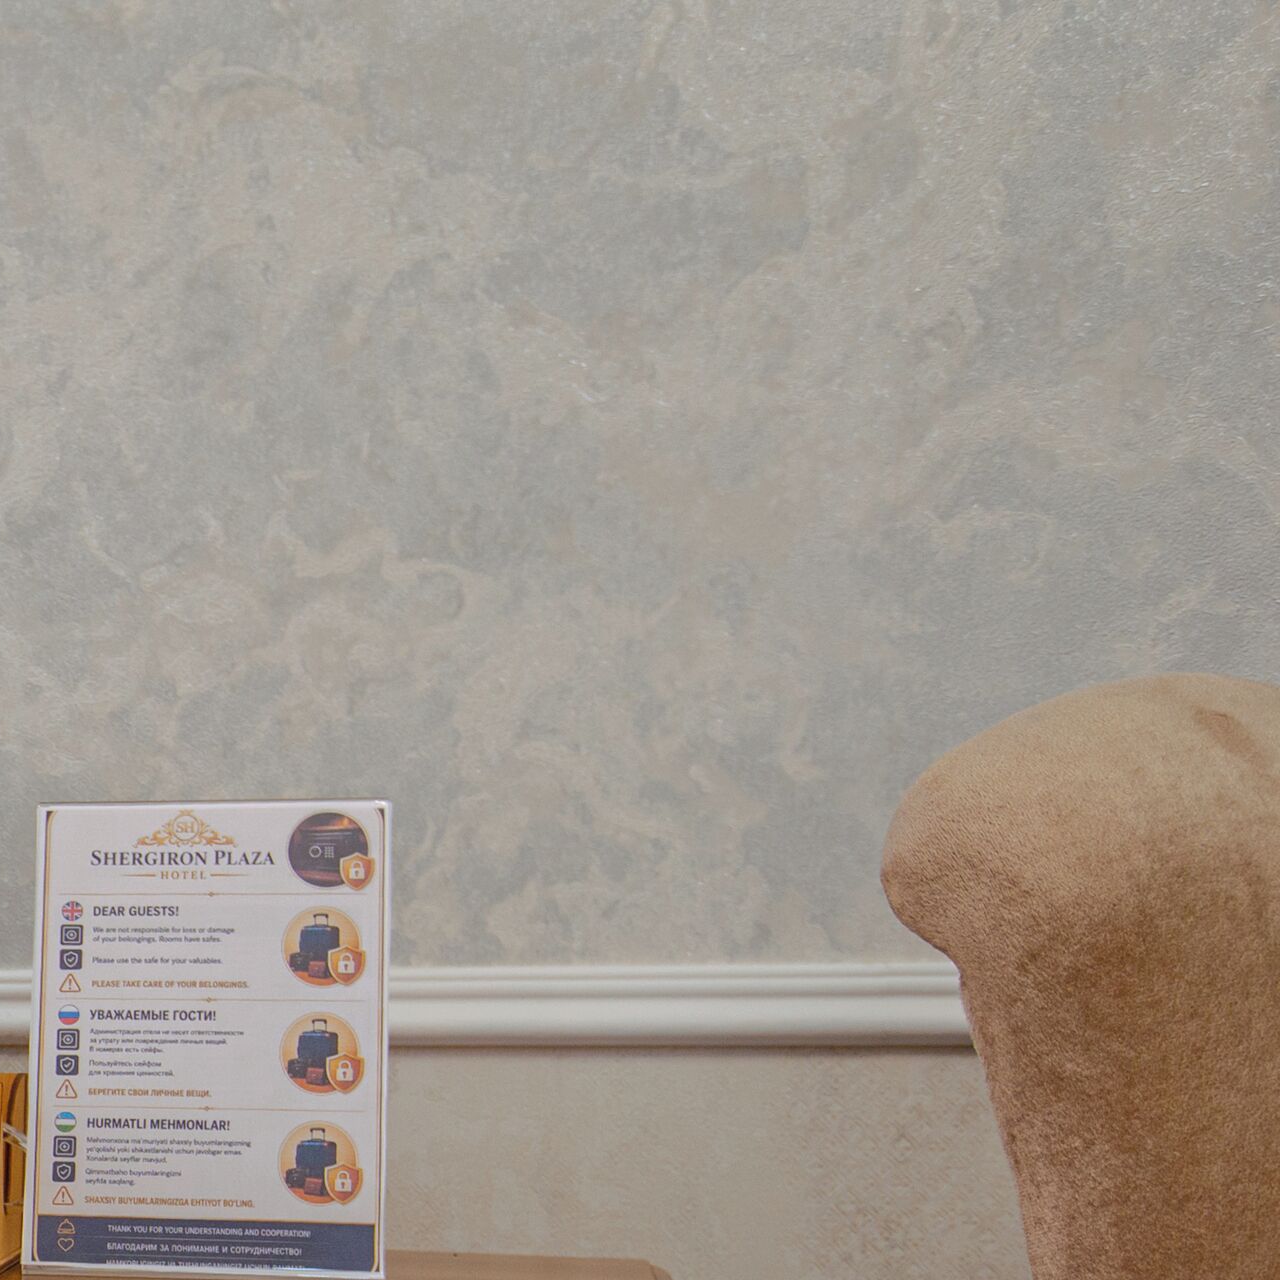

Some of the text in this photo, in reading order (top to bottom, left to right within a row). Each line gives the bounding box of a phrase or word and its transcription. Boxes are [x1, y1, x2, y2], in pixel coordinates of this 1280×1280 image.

[91, 850, 275, 866] SHERGIRON PLAZA
[160, 871, 206, 880] HOTEL
[93, 906, 179, 916] DEAR GUESTS!
[131, 926, 170, 935] responsible
[207, 927, 235, 935] damage
[92, 956, 115, 964] Please
[130, 956, 142, 964] the
[144, 956, 159, 964] safe
[160, 956, 170, 964] for
[92, 980, 120, 988] PLEASE
[122, 980, 140, 988] TAKE
[142, 980, 163, 988] CARE
[165, 980, 174, 988] OF
[177, 980, 197, 988] YOUR
[90, 1009, 217, 1021] УВАЖАЕМЫЕ ГОСТИ!
[88, 1088, 126, 1096] БЕРЕГИТЕ
[128, 1088, 149, 1096] СВОИ
[150, 1089, 184, 1097] ЛИЧНЫЕ
[87, 1118, 230, 1131] HURMATLI MEHMONLAR!
[85, 1196, 116, 1204] SHAXSIY
[108, 1225, 131, 1233] THANK
[133, 1225, 148, 1233] YOU
[164, 1226, 183, 1234] YOUR
[185, 1227, 242, 1236] UNDERSTANDING
[261, 1229, 312, 1238] COOPERATION!
[107, 1242, 157, 1251] БЛАГОДАРИМ
[171, 1244, 219, 1253] ПОНИМАНИЕ
[230, 1247, 302, 1257] СОТРУДНИЧЕСТВО!
